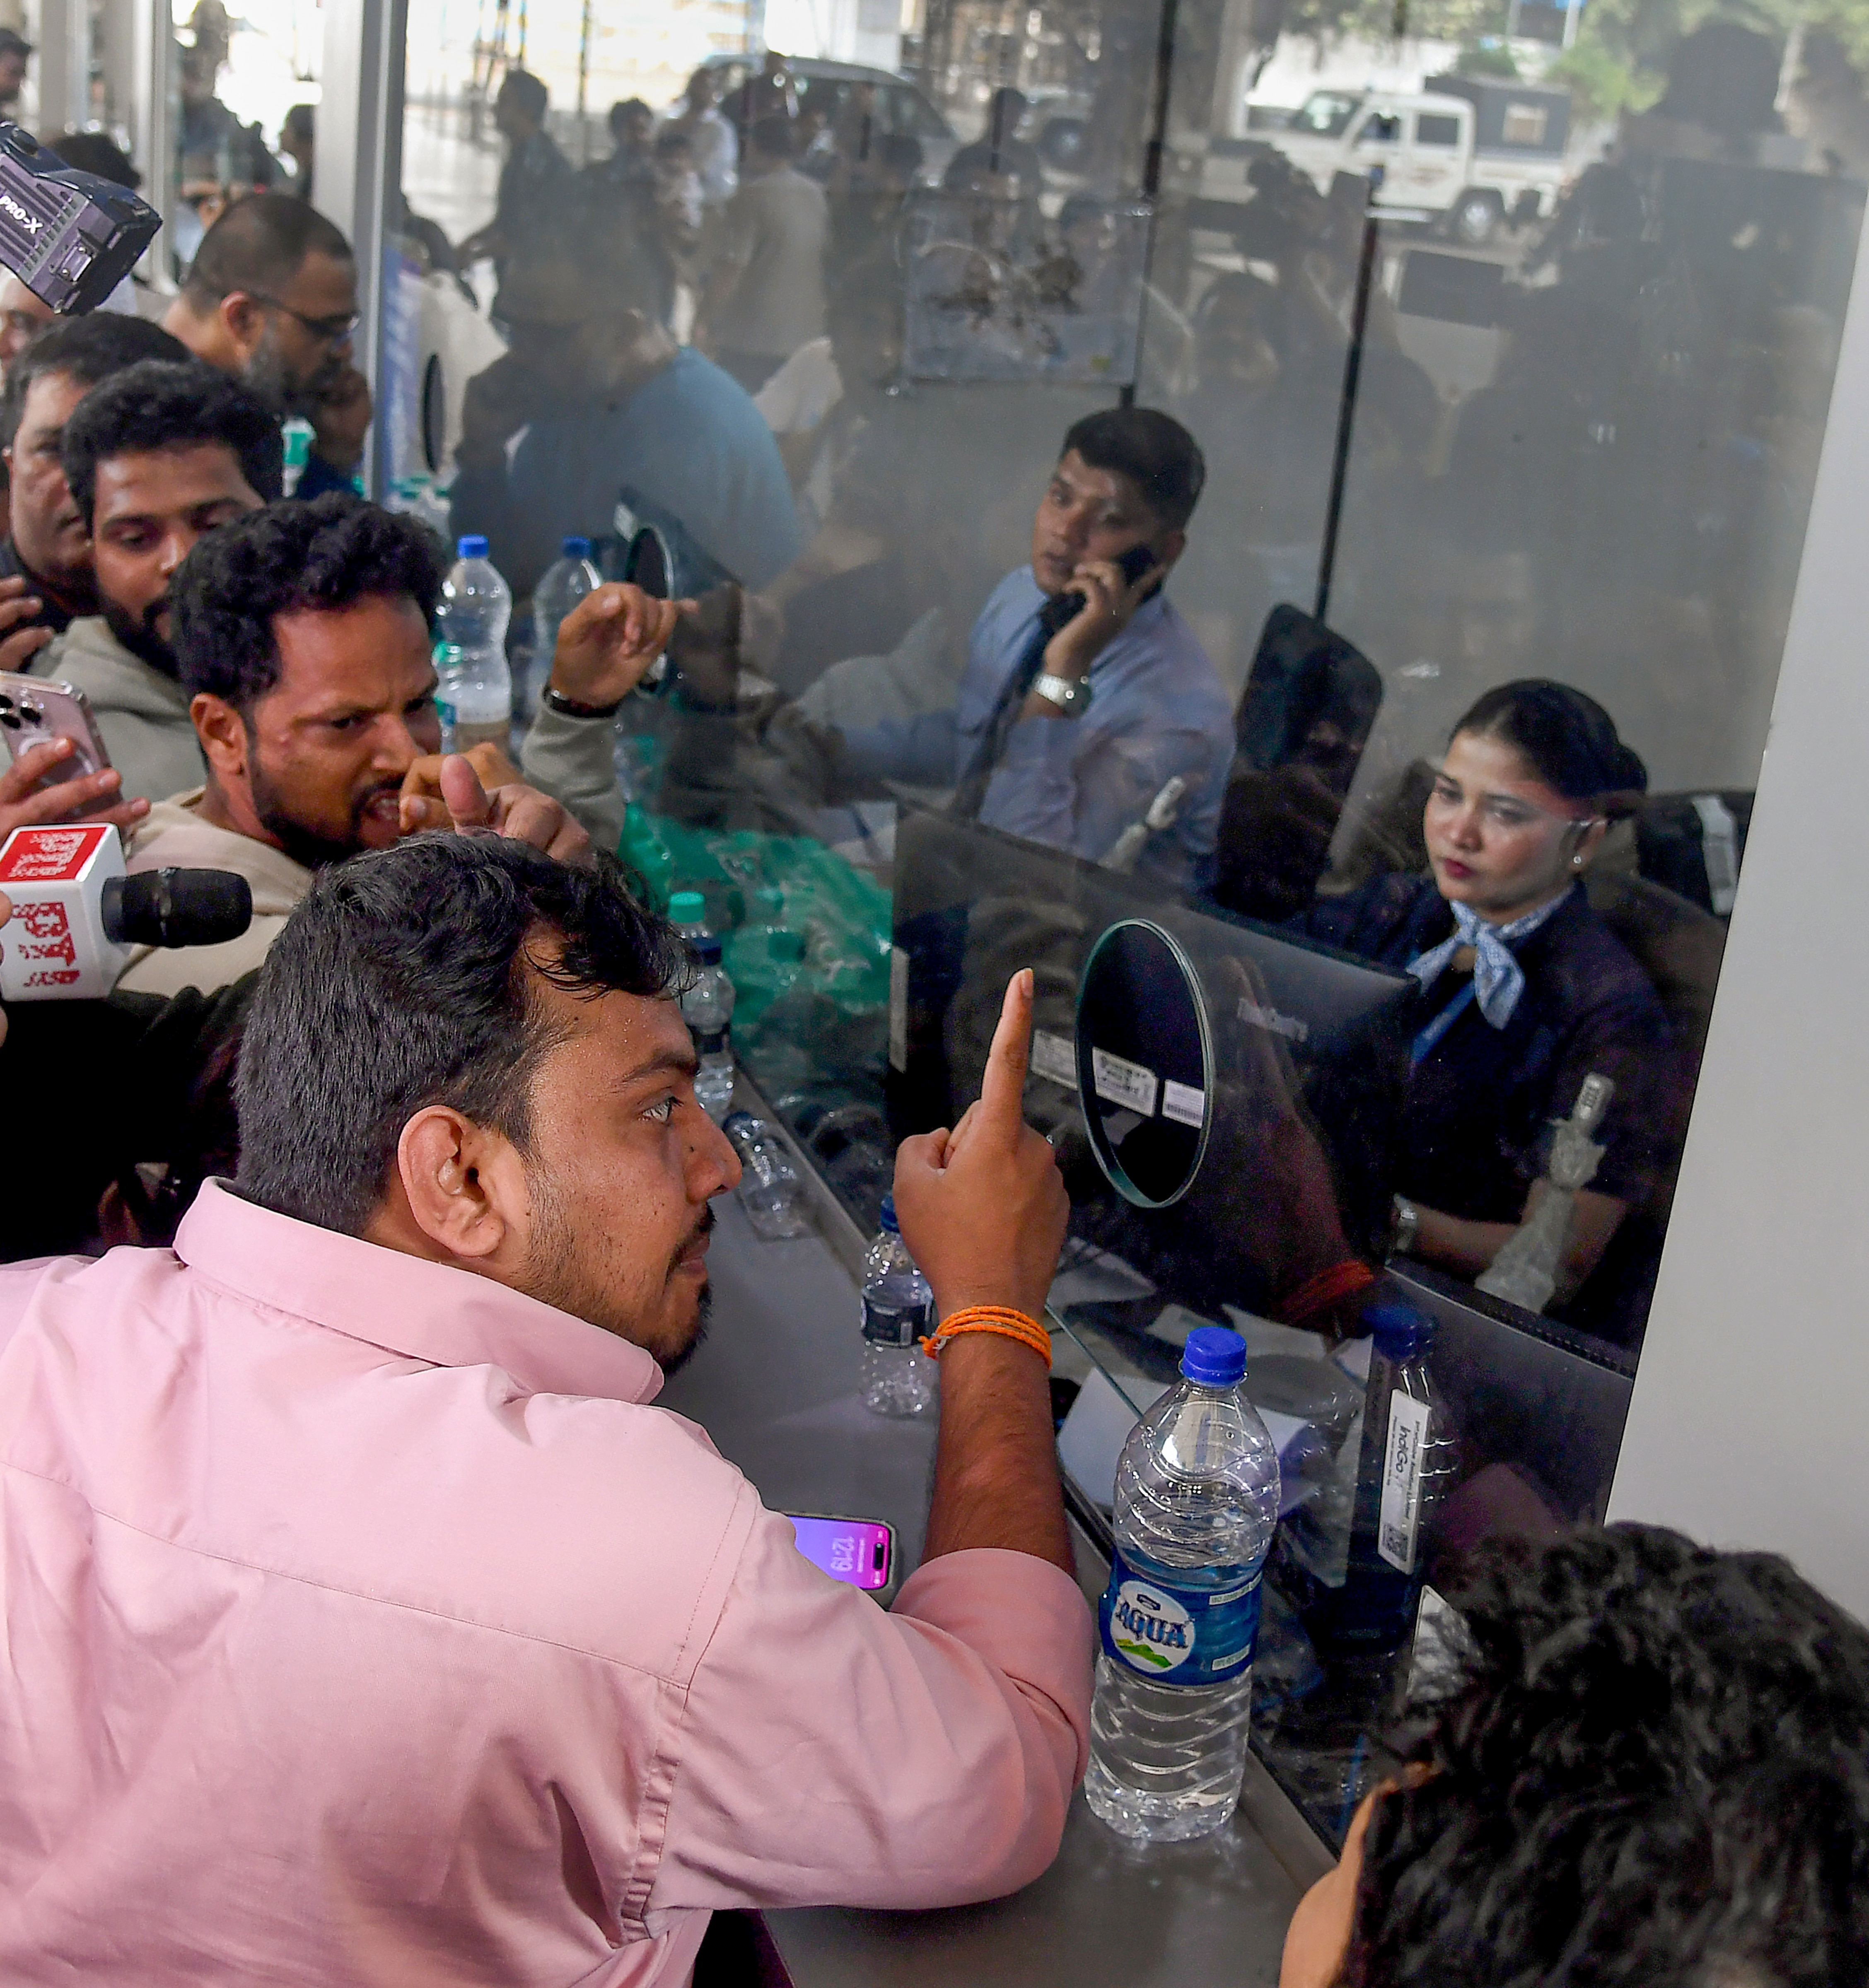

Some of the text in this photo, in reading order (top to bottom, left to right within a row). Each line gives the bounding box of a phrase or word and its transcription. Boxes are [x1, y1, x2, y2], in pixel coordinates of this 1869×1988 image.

[0, 195, 43, 234] PRO-X
[12, 902, 80, 987] PTI
[1396, 1424, 1411, 1474] IndiGo
[1115, 1600, 1189, 1649] AQUA
